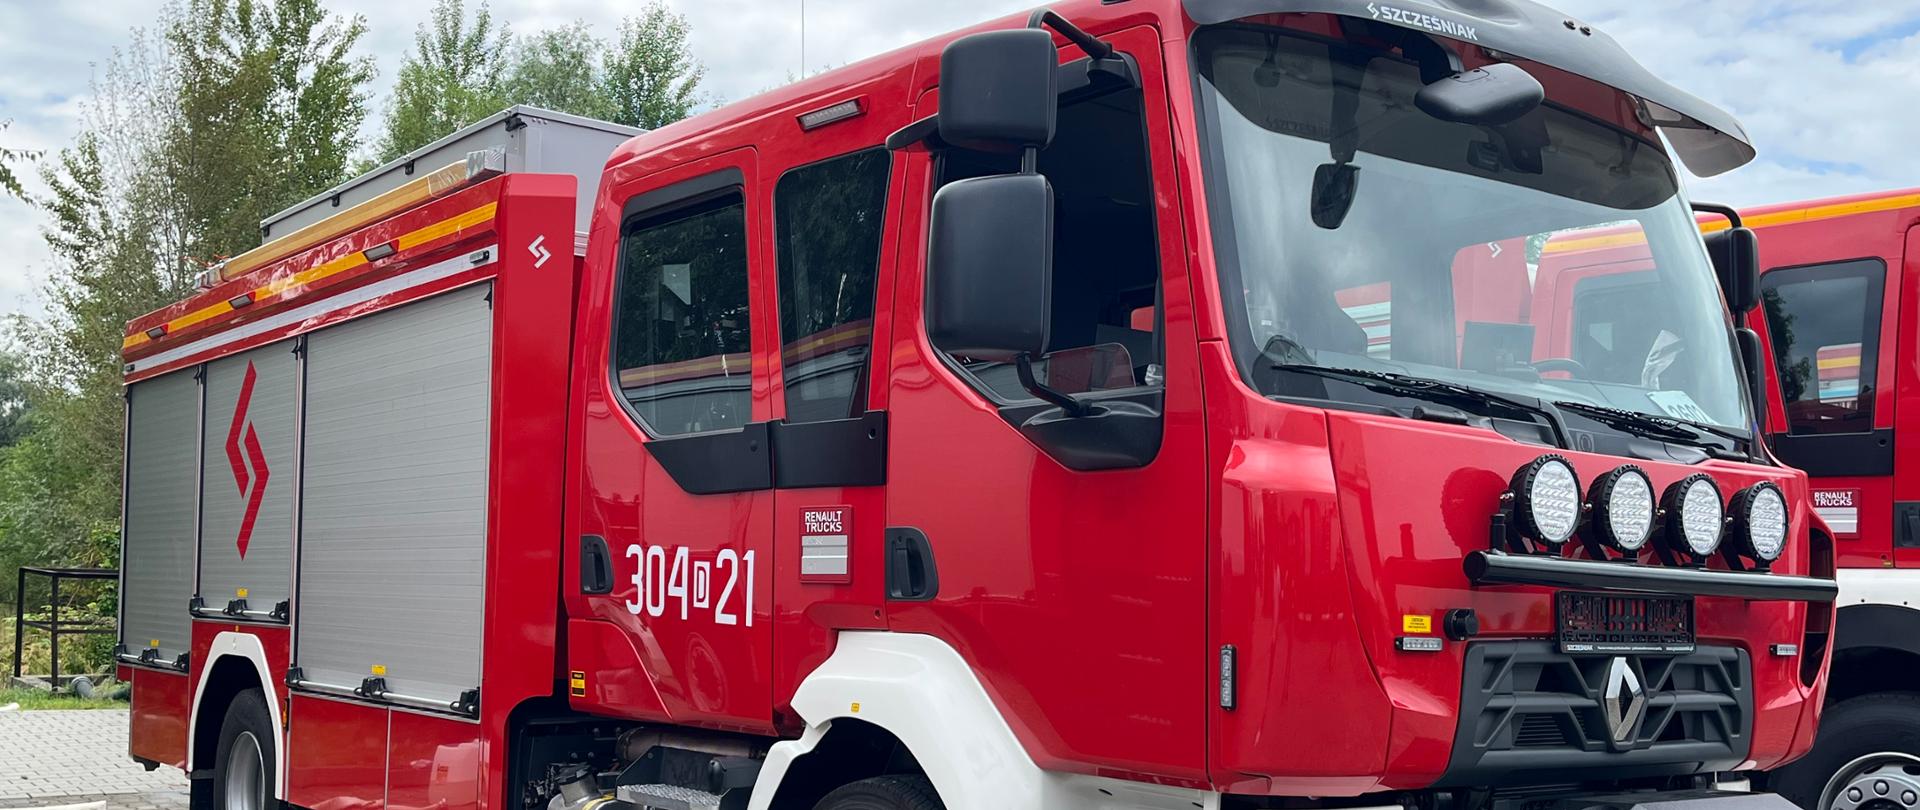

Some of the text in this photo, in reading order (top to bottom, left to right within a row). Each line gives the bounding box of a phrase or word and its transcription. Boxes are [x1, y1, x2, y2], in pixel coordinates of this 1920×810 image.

[1380, 6, 1478, 41] SZCZĘŚNIAK
[1814, 491, 1853, 500] RENAULT
[1815, 499, 1853, 507] TRUCKS
[804, 510, 843, 522] RENAULT
[805, 522, 843, 533] TRUCKS
